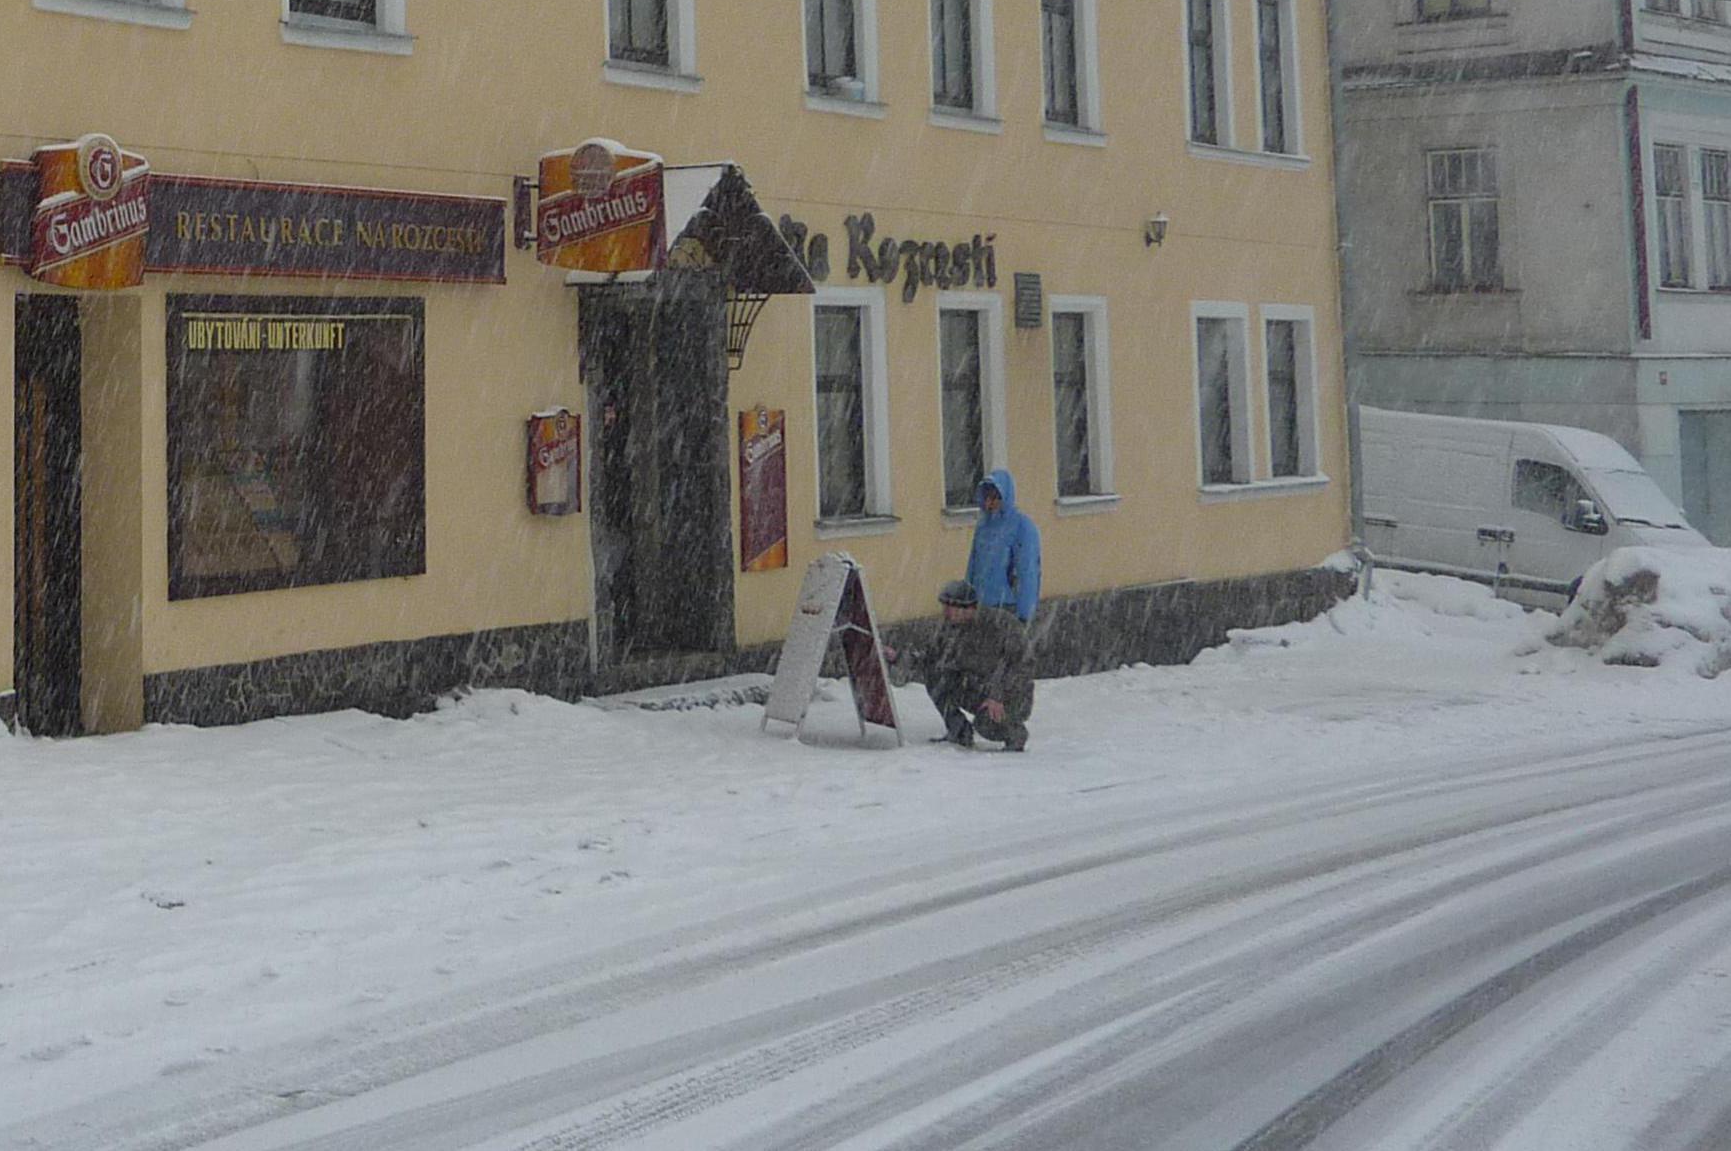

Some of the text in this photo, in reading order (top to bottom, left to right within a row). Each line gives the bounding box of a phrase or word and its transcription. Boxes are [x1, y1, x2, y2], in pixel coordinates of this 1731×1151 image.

[47, 196, 147, 254] Gambrinus
[176, 210, 344, 246] RESTAURACE
[542, 191, 648, 242] Gambrinus
